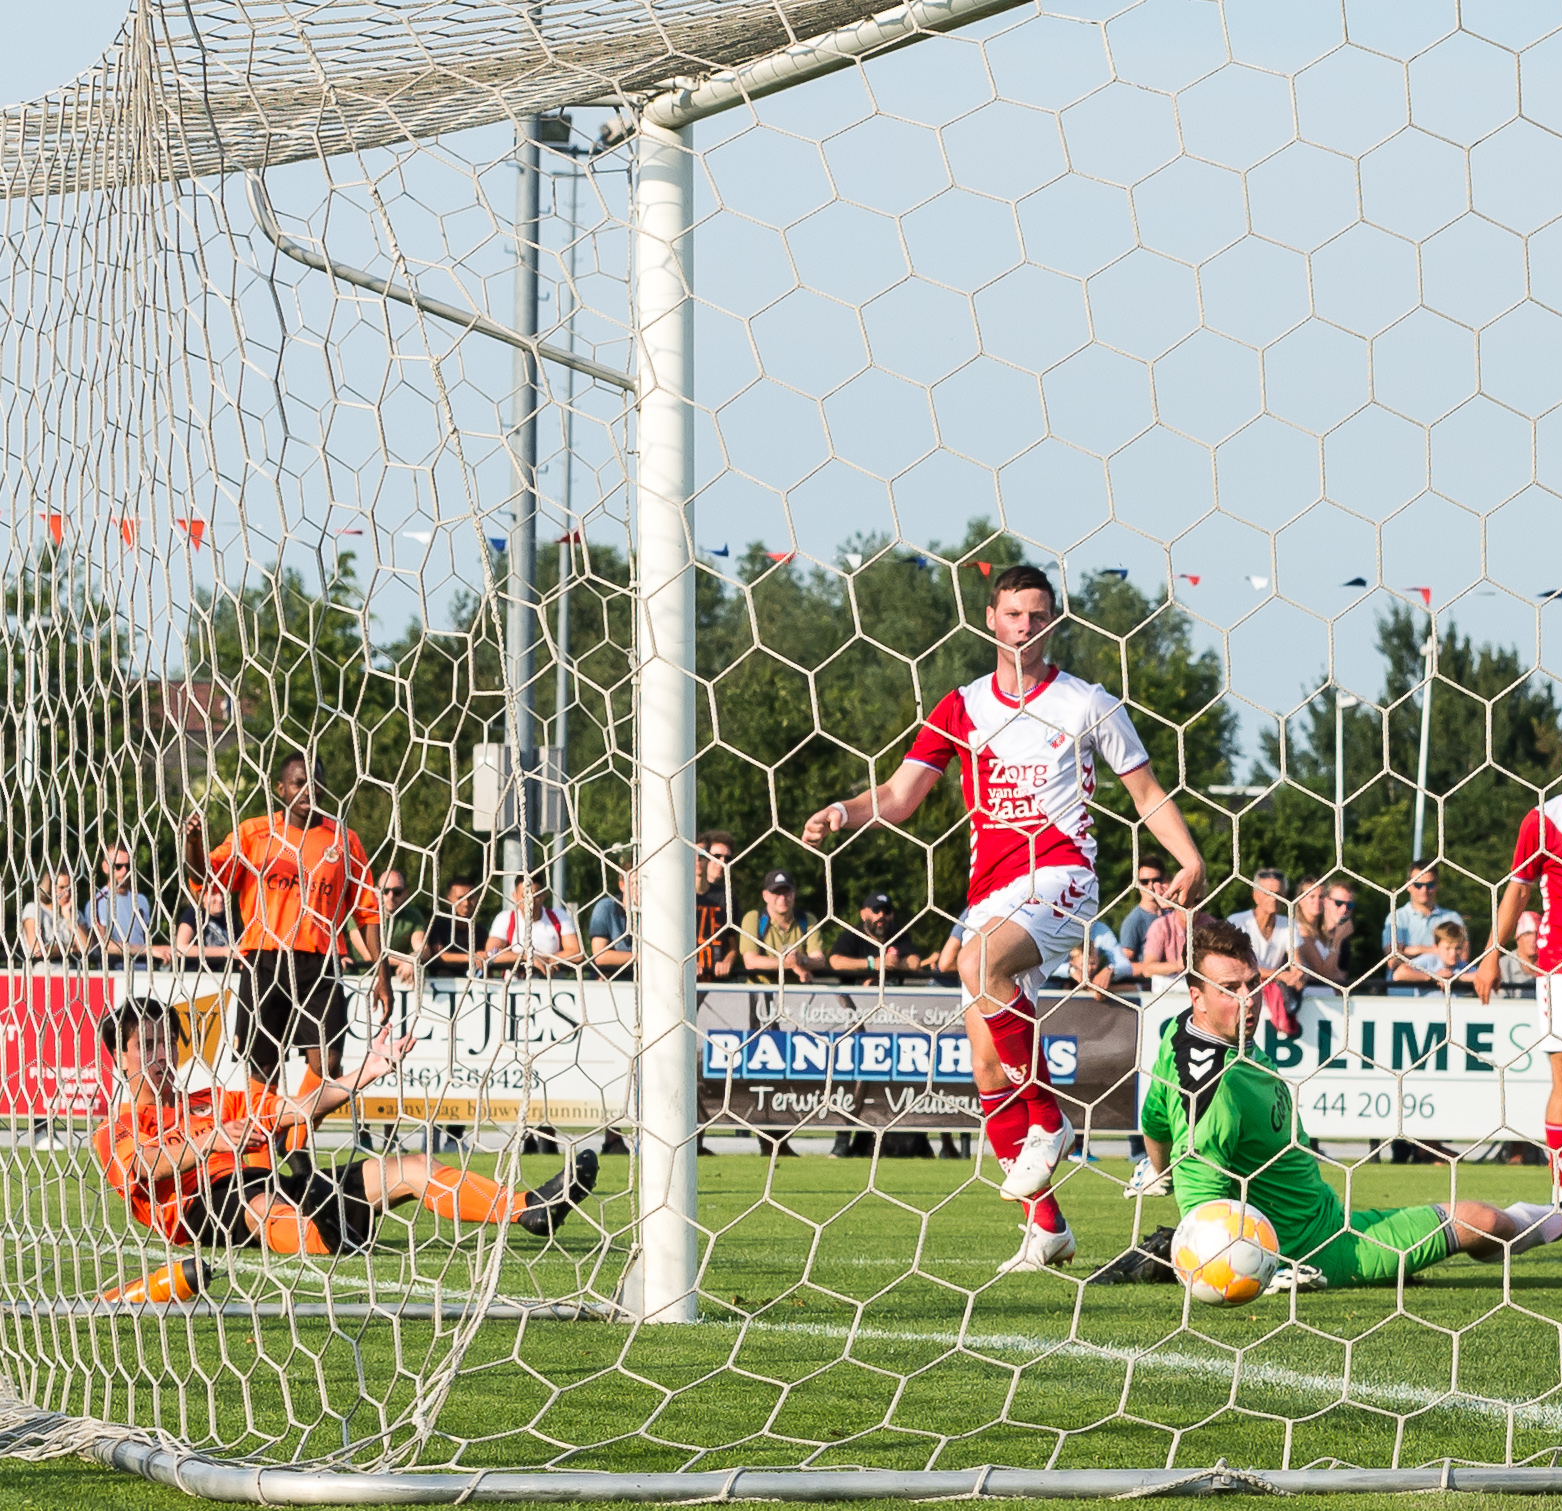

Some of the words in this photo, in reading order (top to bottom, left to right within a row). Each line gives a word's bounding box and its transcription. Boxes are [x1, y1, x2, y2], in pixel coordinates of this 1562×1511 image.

[988, 758, 1048, 788] Zorg
[987, 793, 1047, 820] Zaak
[267, 873, 334, 896] GoFsio
[709, 1033, 1077, 1075] BANIERHS
[749, 1086, 854, 1119] Terwijde
[1313, 1093, 1346, 1116] 44
[1358, 1093, 1391, 1118] 20
[1402, 1094, 1435, 1118] 96
